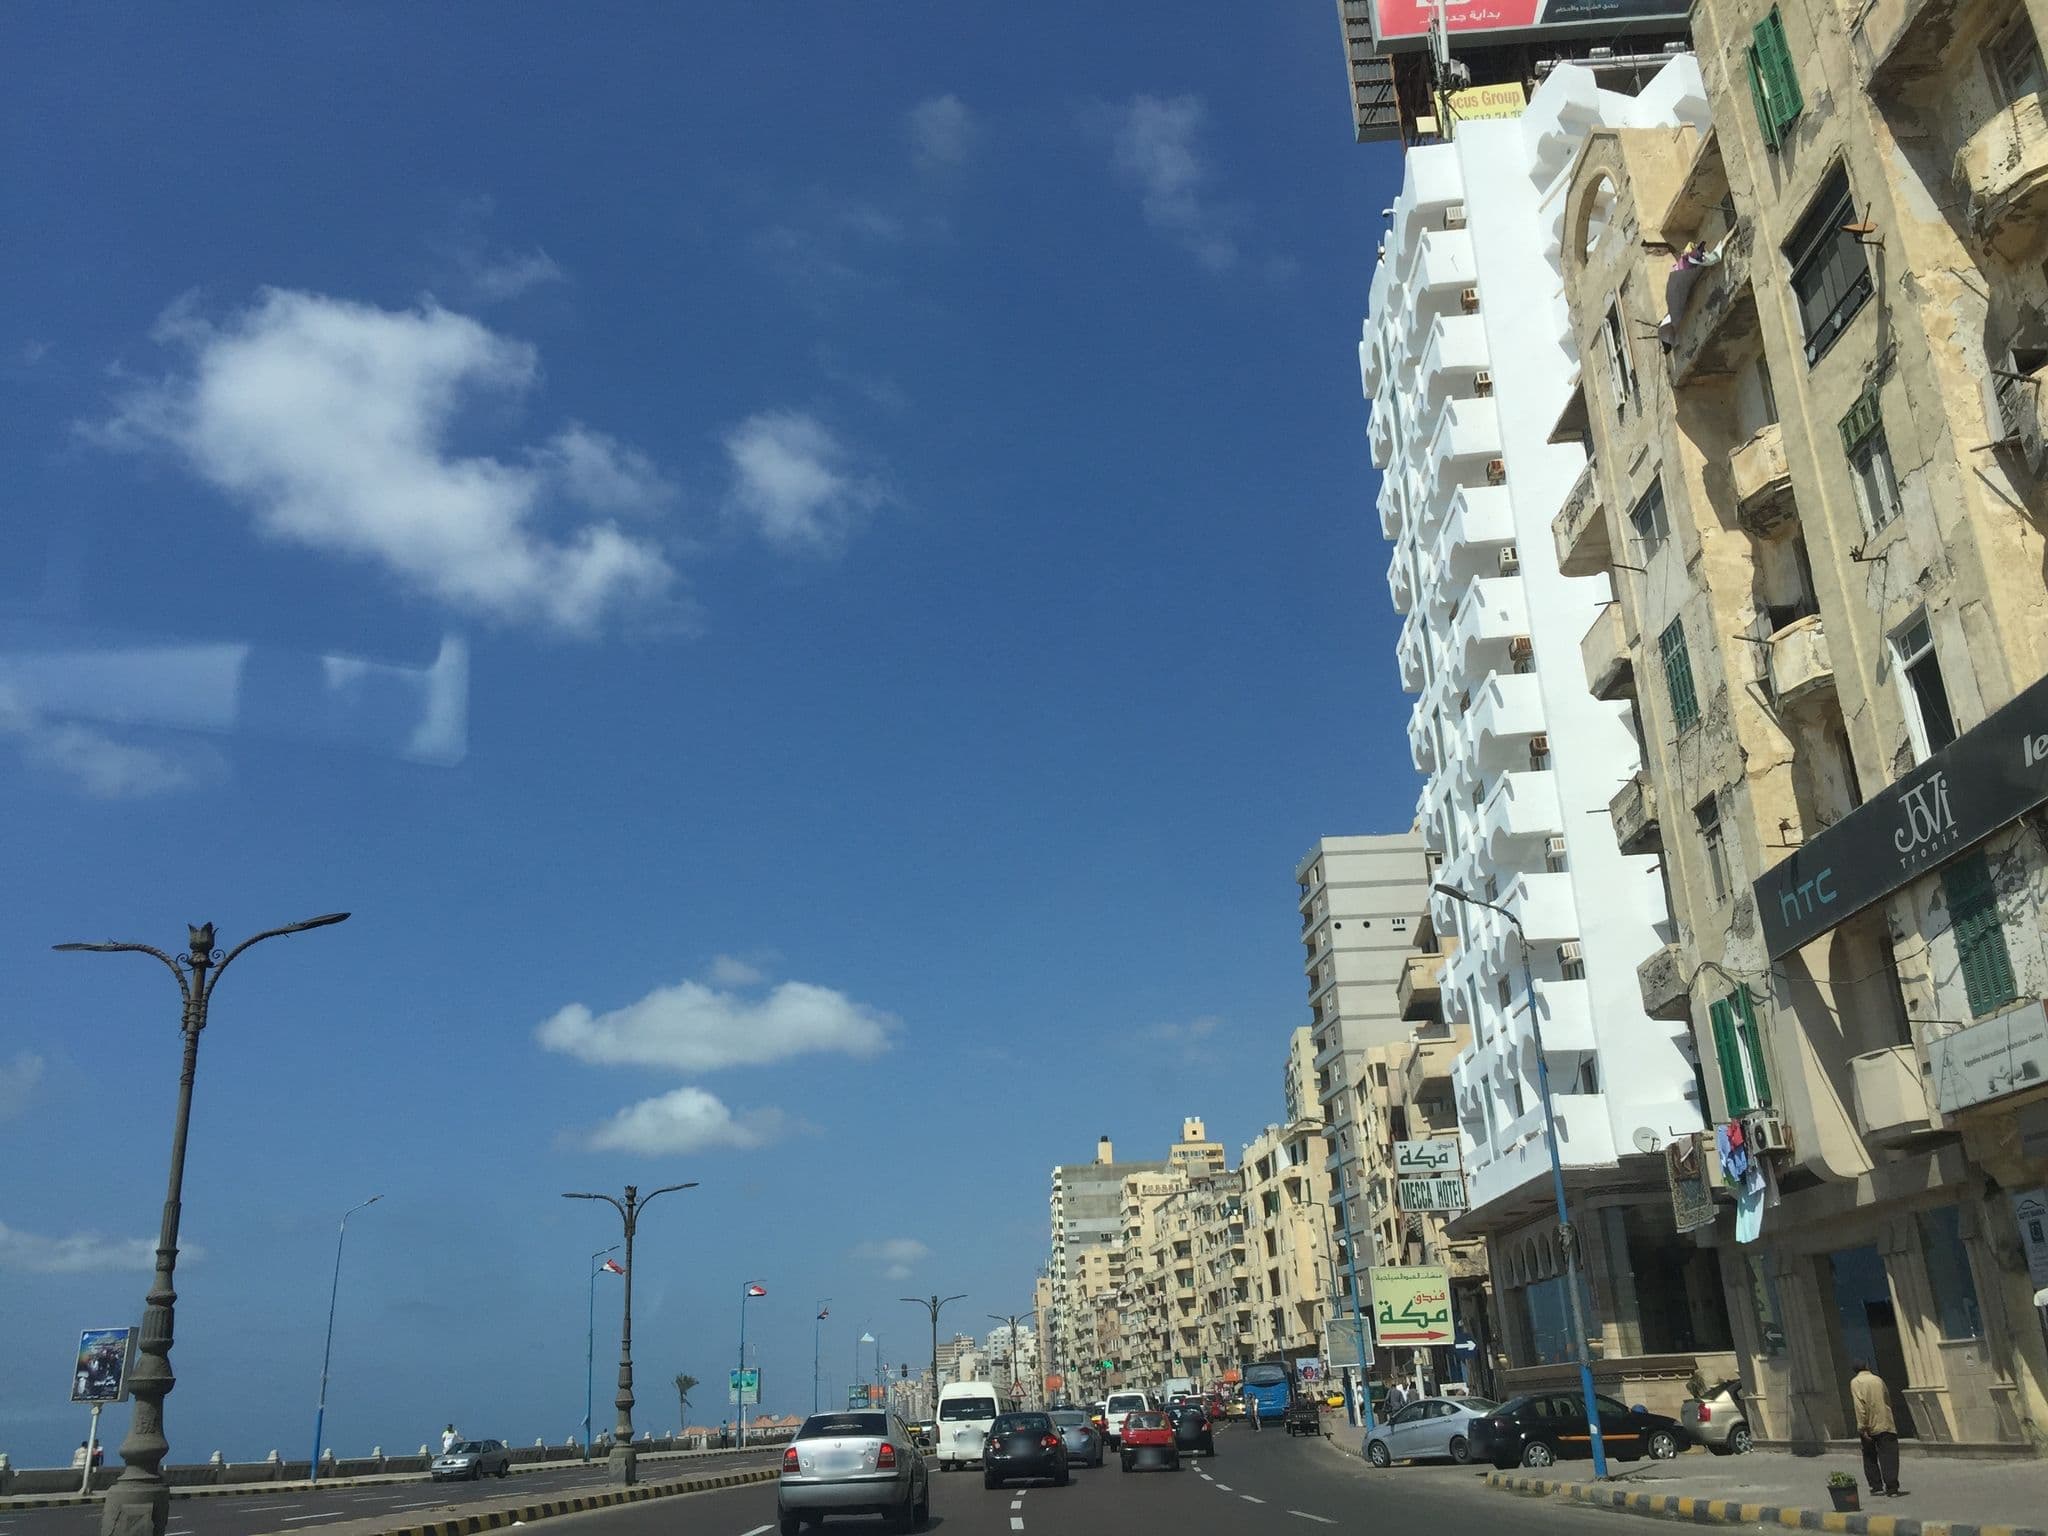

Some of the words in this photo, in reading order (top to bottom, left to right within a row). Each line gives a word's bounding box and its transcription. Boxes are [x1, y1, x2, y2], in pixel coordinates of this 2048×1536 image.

[1469, 9, 1502, 22] بداية
[1481, 89, 1520, 107] Group
[1899, 829, 1960, 869] Tronix
[1398, 1145, 1449, 1169] مكة
[1400, 1181, 1435, 1210] MECCA
[1435, 1180, 1465, 1208] HOTEL
[1413, 1289, 1446, 1305] فندق
[1378, 1300, 1449, 1329] مكة
